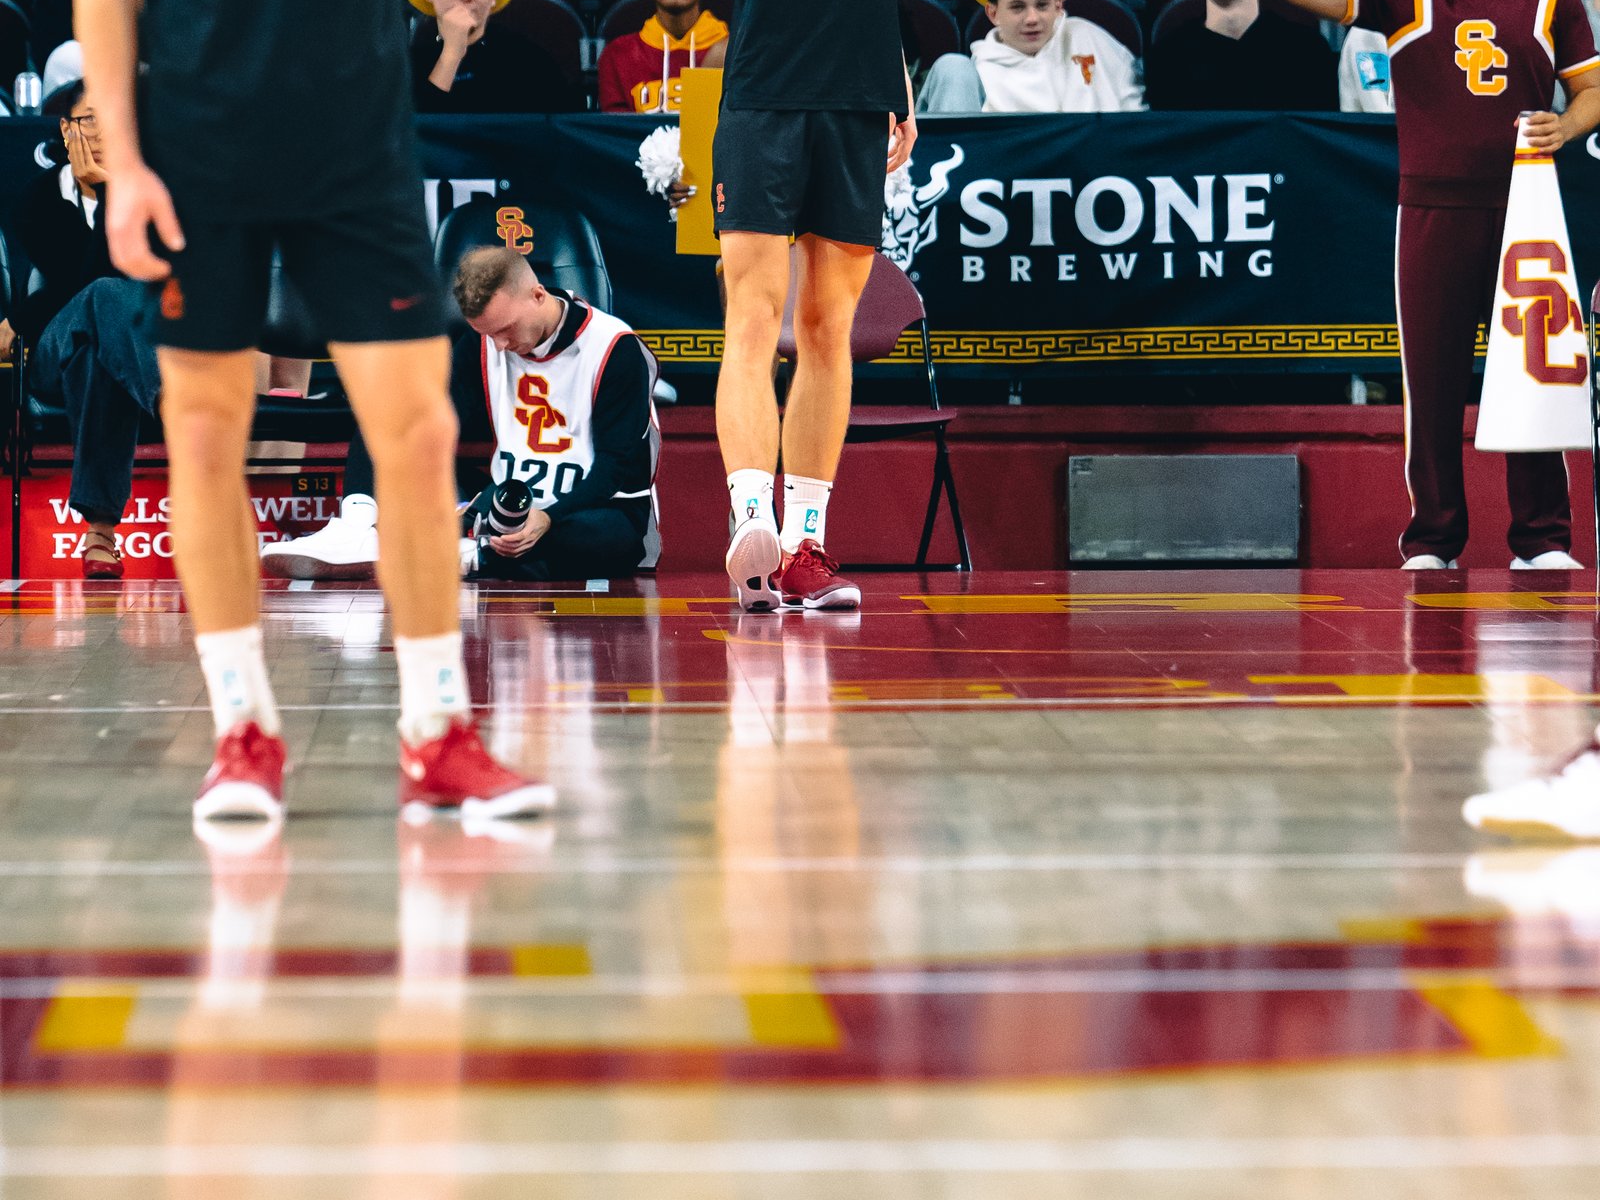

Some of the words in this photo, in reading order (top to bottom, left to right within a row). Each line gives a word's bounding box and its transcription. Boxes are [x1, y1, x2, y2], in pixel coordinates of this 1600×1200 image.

[1454, 19, 1508, 96] SC
[496, 206, 534, 254] SC
[962, 249, 1273, 282] BREWING
[1502, 239, 1588, 386] SC
[515, 372, 572, 453] SC
[297, 478, 308, 491] S
[314, 477, 329, 490] 13
